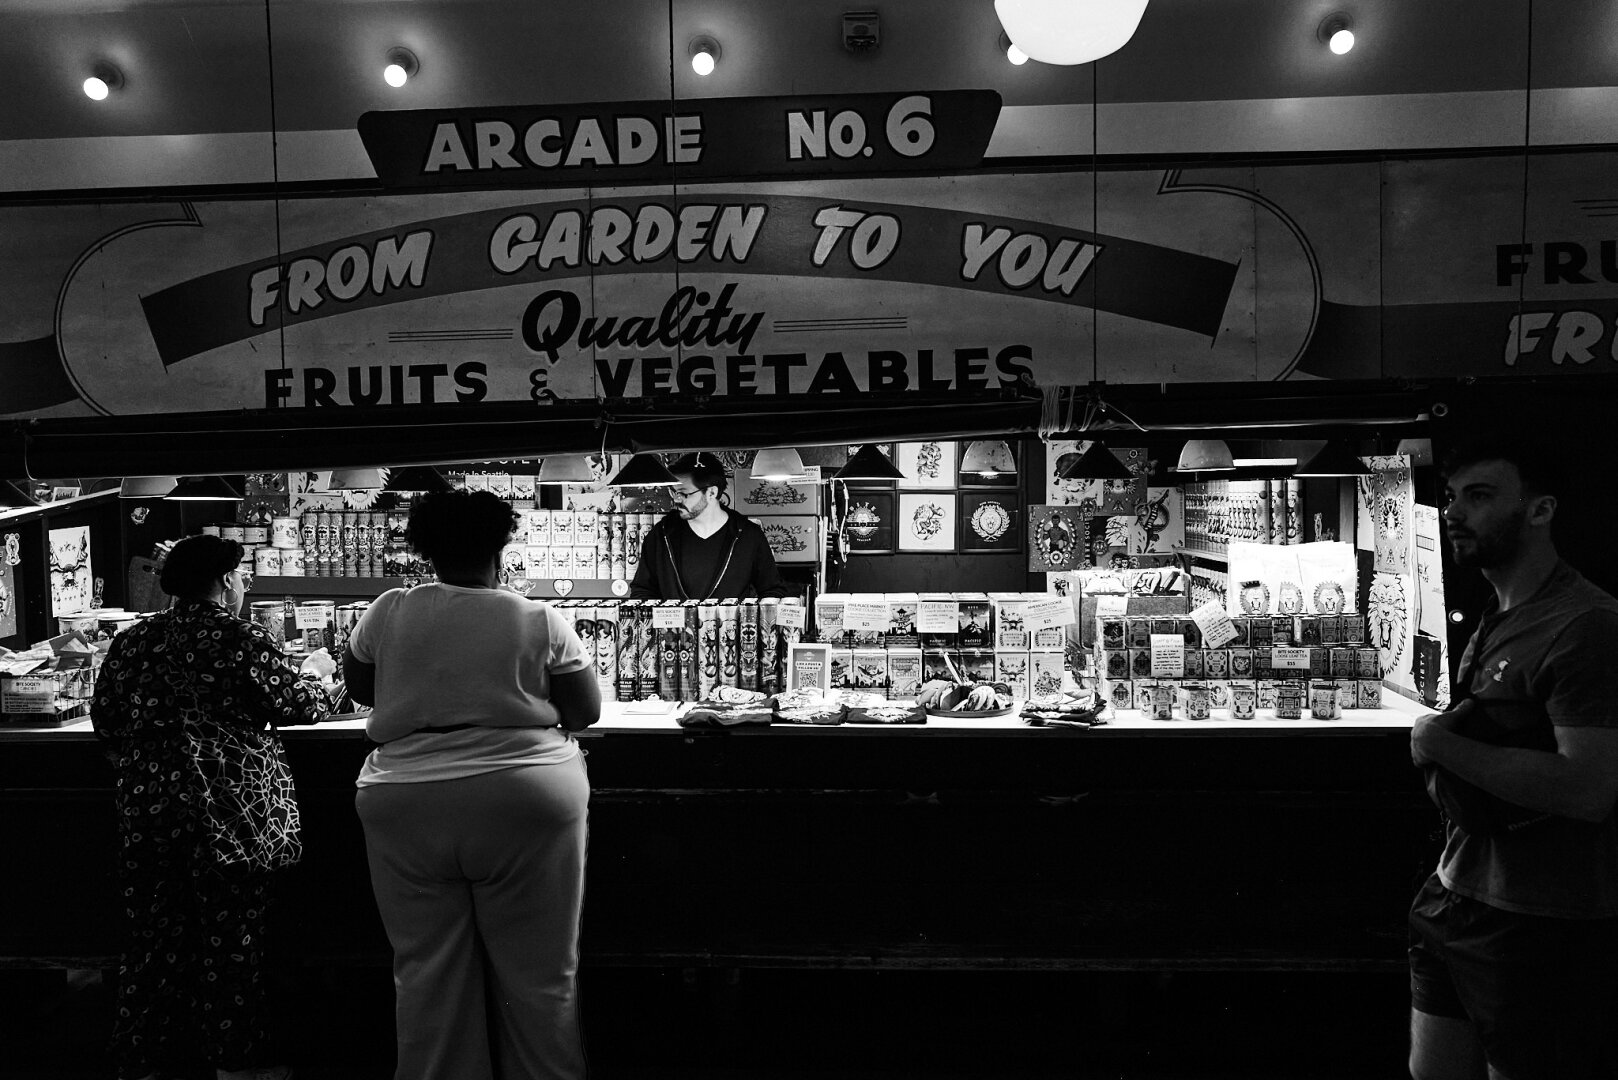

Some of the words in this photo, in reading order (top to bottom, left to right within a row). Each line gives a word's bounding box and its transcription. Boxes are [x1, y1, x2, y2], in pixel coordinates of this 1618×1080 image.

[424, 115, 701, 172] ARCADE
[787, 110, 874, 158] NO.
[886, 96, 935, 156] 6
[249, 230, 433, 326] FROM
[489, 205, 767, 273] GARDEN
[813, 206, 899, 270] TO
[961, 223, 1103, 296] YOU
[522, 283, 766, 364] Quality
[1504, 311, 1618, 367] FR
[264, 361, 488, 407] FRUITS
[530, 368, 558, 404] &
[594, 345, 1034, 398] VEGETABLES
